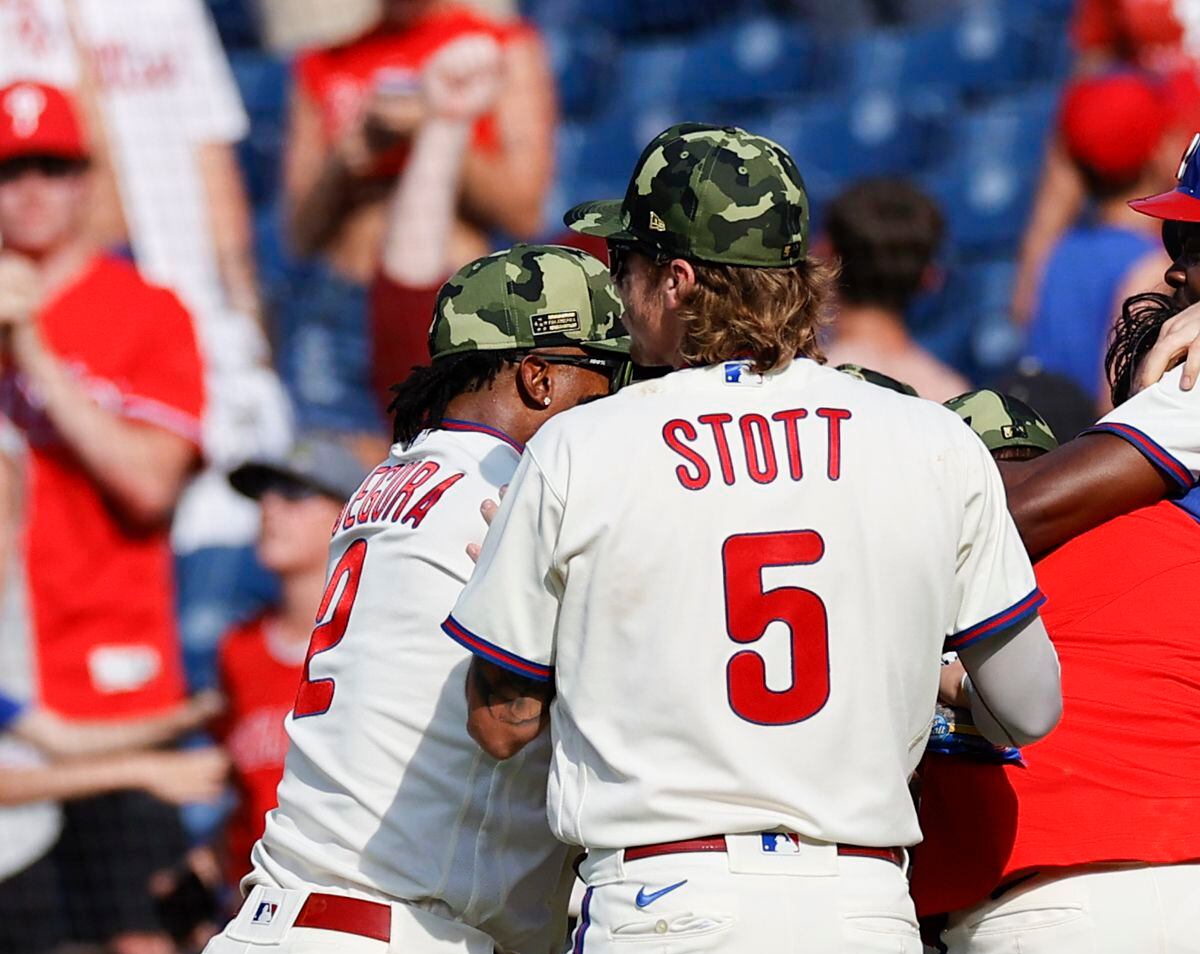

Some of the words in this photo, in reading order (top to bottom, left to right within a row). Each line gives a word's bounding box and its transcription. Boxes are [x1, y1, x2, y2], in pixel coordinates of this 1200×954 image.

[662, 407, 852, 490] STOTT
[293, 538, 369, 720] 2
[721, 528, 831, 726] 5
